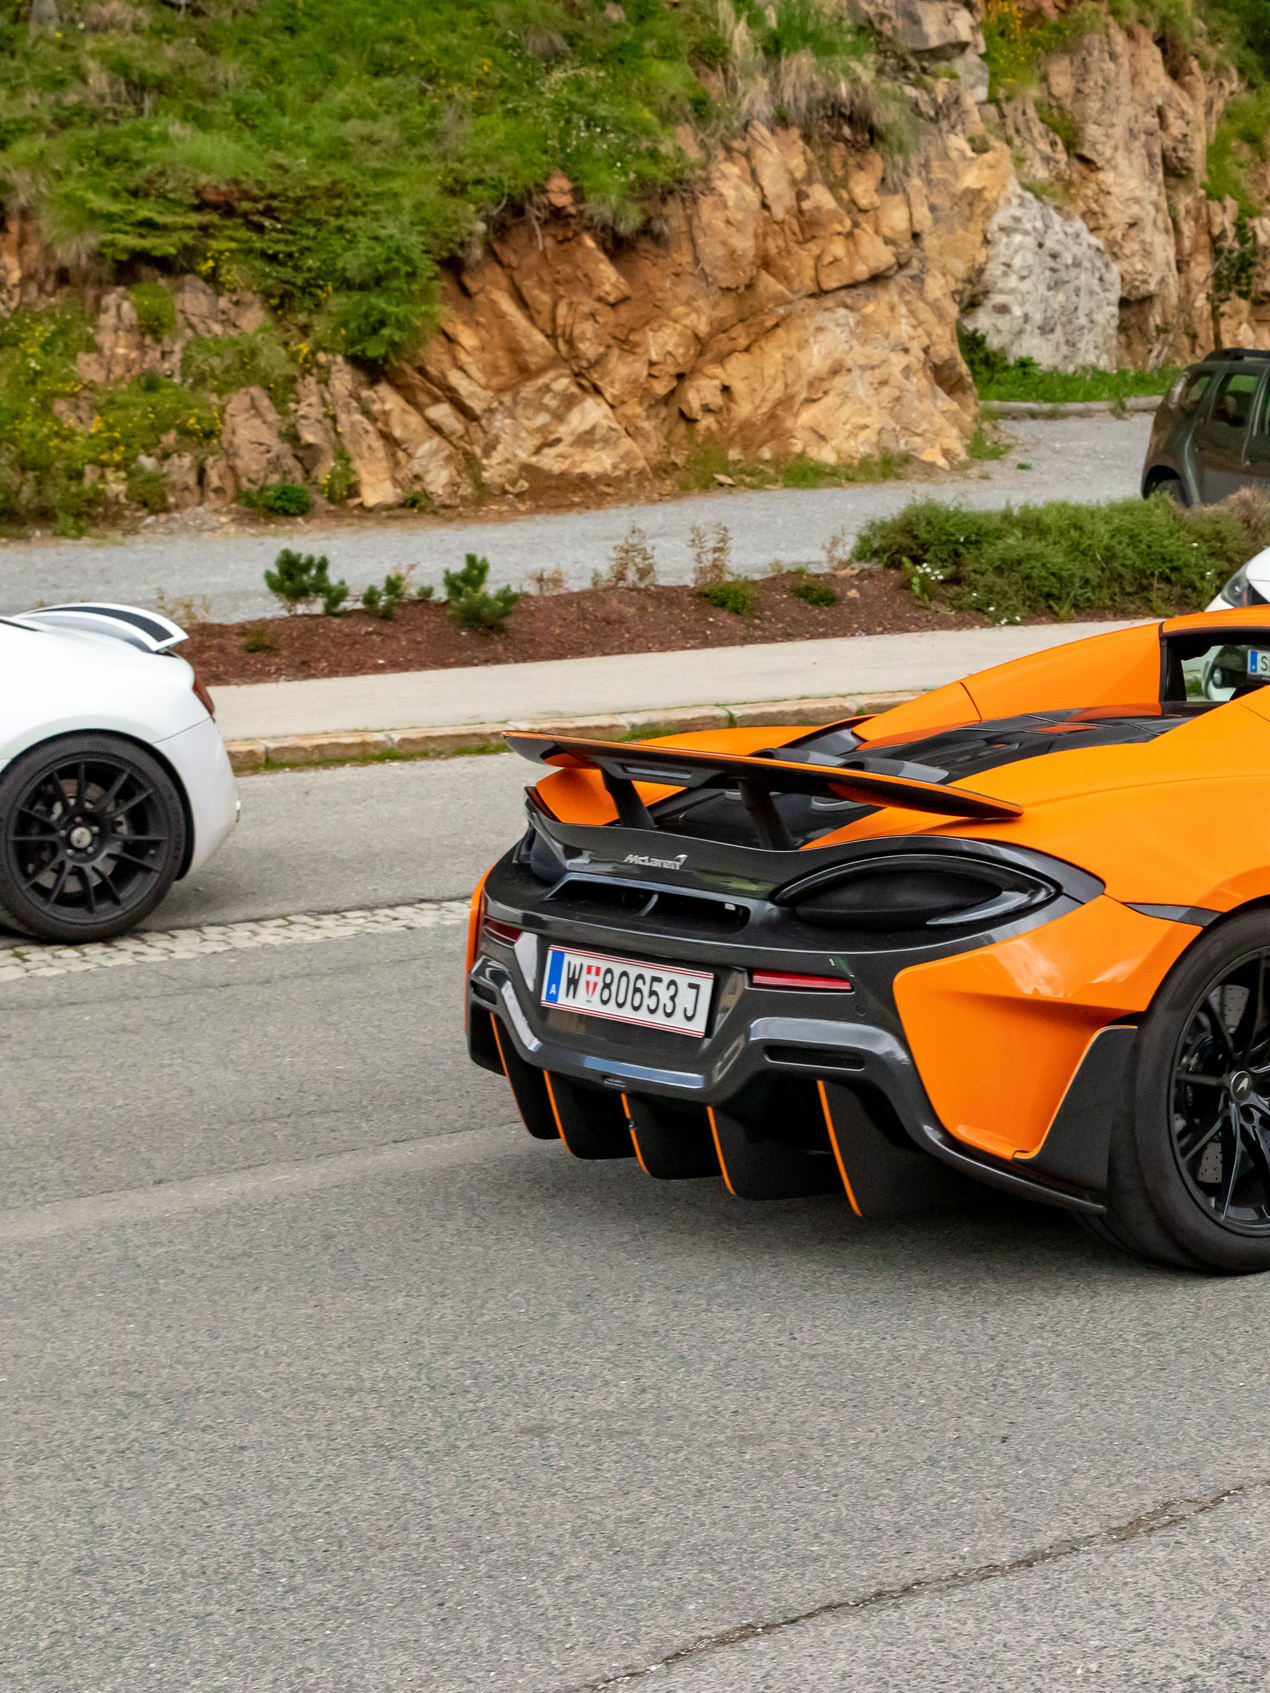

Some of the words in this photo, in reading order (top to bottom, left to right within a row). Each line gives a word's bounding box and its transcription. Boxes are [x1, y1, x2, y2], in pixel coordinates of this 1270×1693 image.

[623, 854, 681, 870] McLaren
[549, 984, 556, 995] A
[565, 960, 583, 999] W
